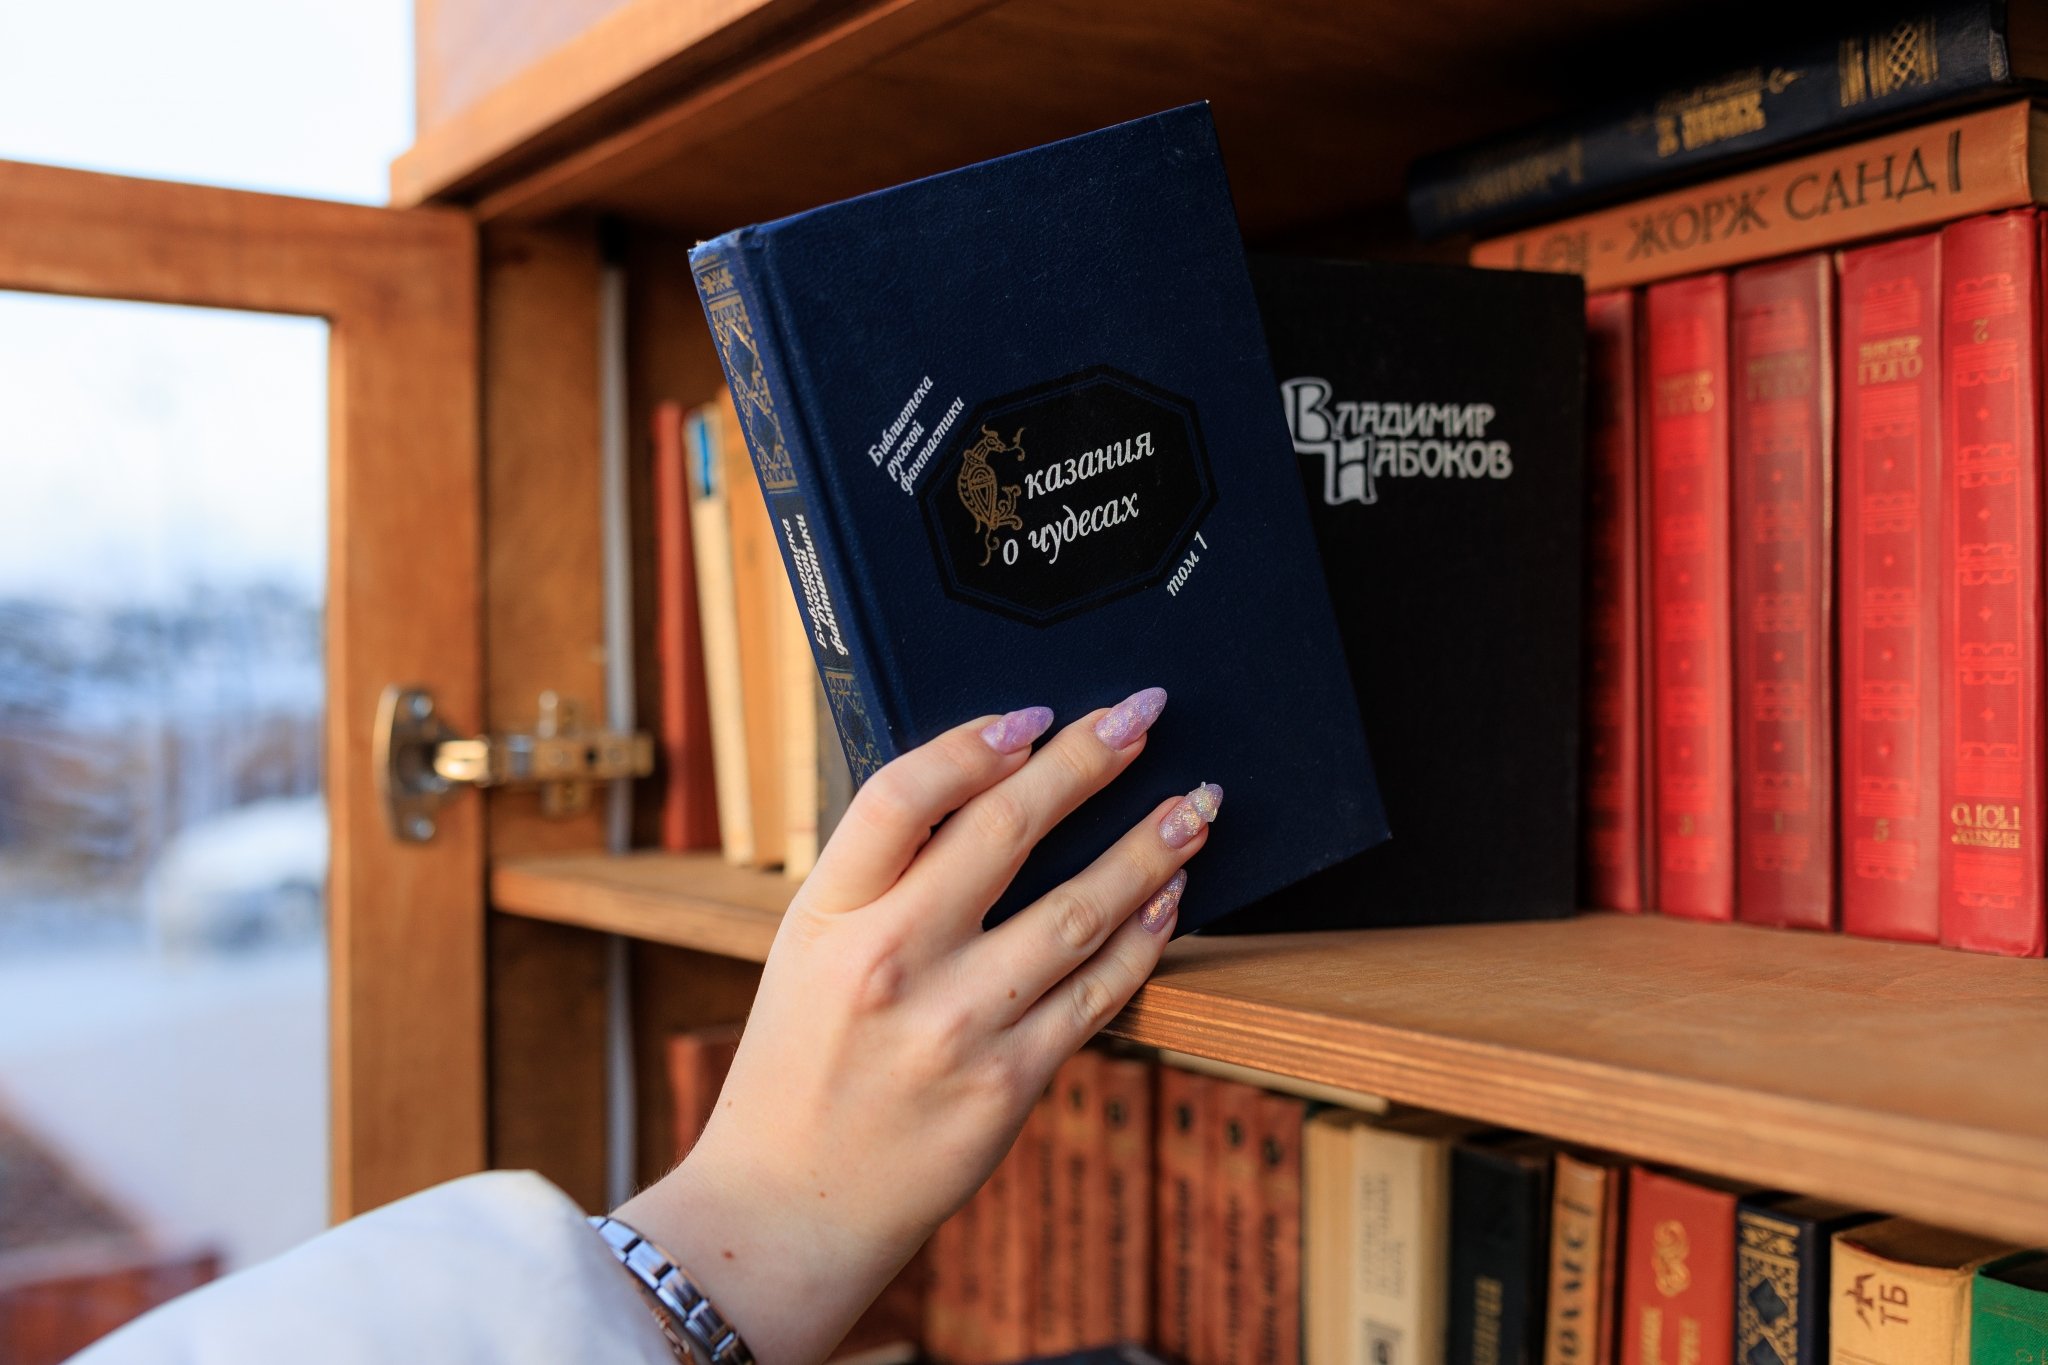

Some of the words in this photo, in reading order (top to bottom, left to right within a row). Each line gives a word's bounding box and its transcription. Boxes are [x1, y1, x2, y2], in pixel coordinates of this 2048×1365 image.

[1786, 146, 1937, 220] САНД
[867, 375, 933, 467] Библиотека
[887, 419, 925, 481] русской
[900, 396, 964, 496] фантастики
[1002, 538, 1019, 566] о
[1027, 493, 1140, 565] чудесах
[1166, 550, 1200, 597] том
